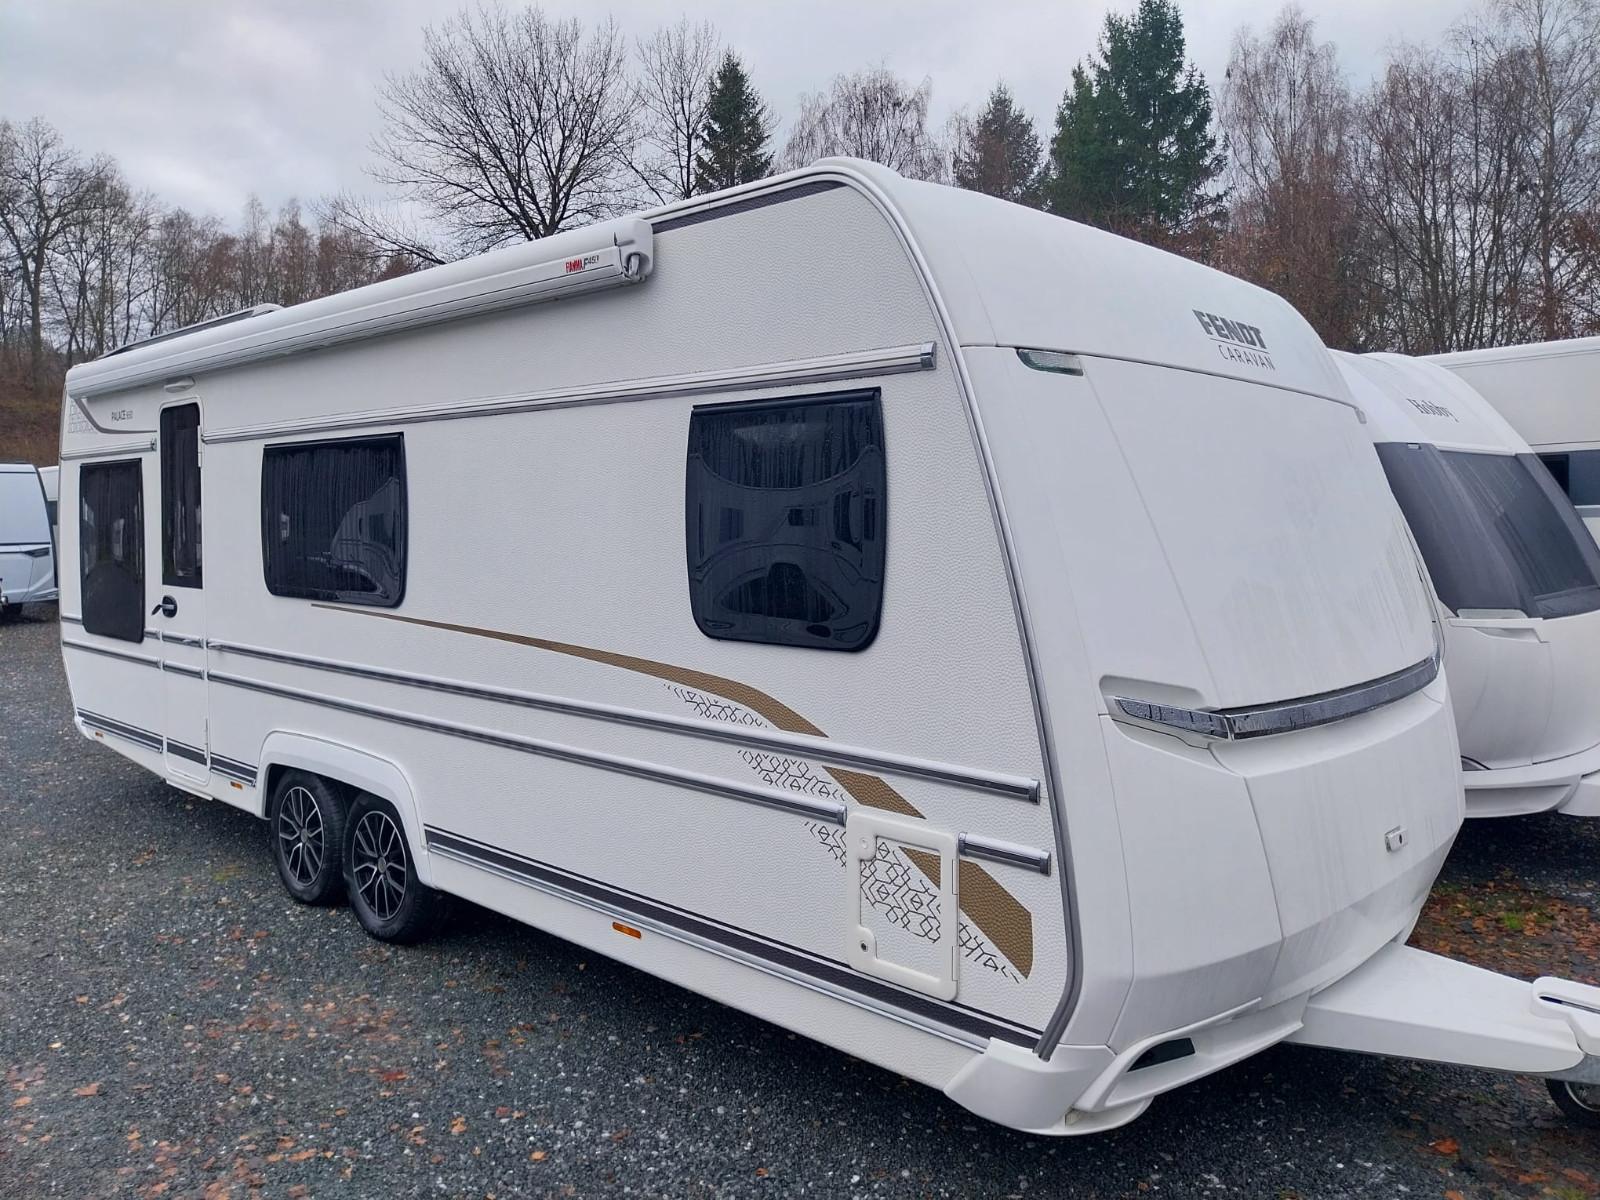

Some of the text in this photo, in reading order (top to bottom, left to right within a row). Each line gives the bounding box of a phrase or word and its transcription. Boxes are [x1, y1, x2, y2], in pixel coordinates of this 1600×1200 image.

[1192, 309, 1267, 350] FENDT
[1218, 345, 1275, 370] CARAVAN
[1406, 398, 1459, 423] Hobby
